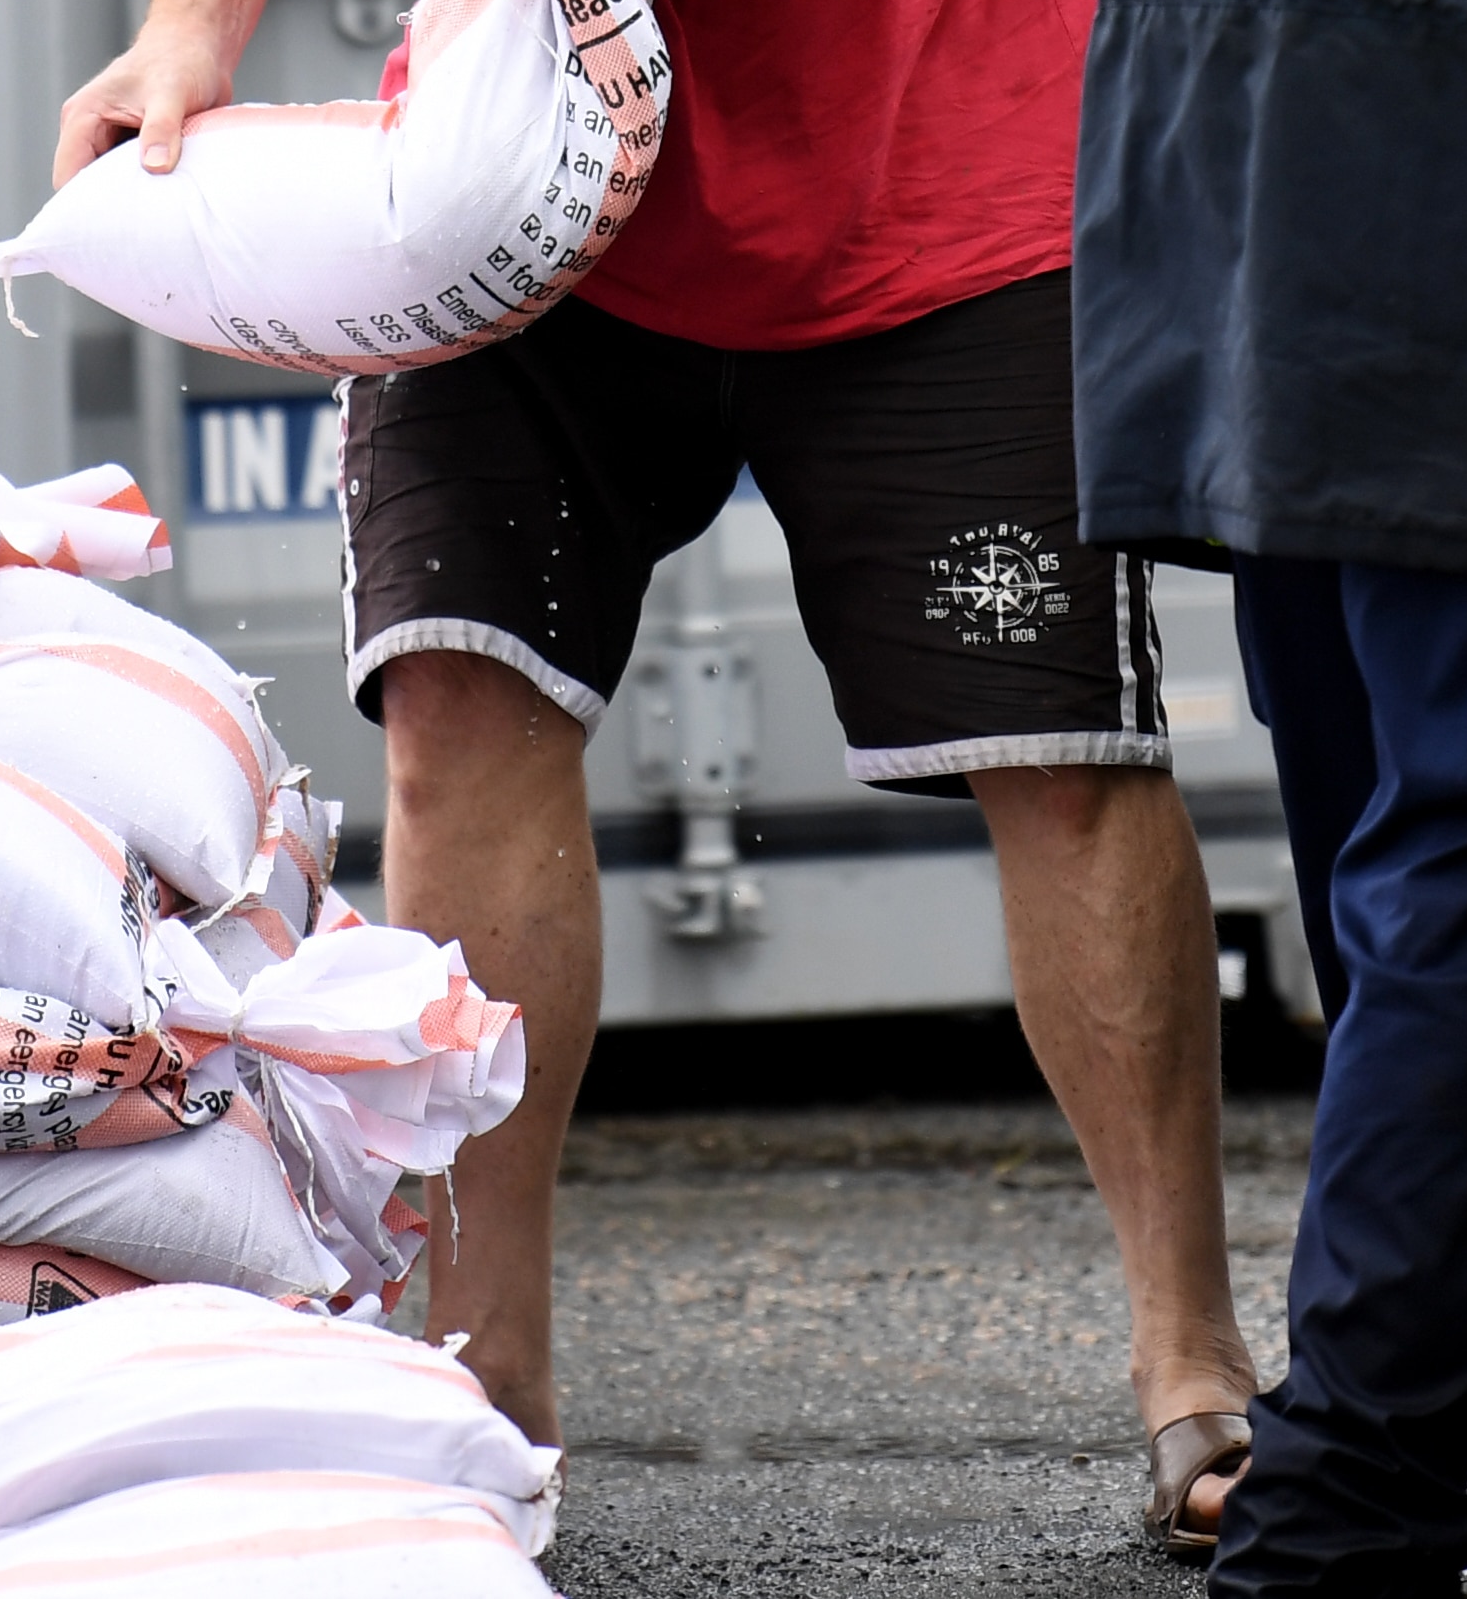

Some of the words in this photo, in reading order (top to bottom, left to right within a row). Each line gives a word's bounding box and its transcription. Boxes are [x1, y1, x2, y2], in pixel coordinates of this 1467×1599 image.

[584, 109, 615, 140] an
[573, 151, 604, 185] an
[562, 196, 593, 229] an
[540, 235, 559, 260] a
[369, 312, 412, 345] SES
[201, 407, 289, 514] IN
[1037, 553, 1060, 572] 85
[22, 992, 48, 1024] an
